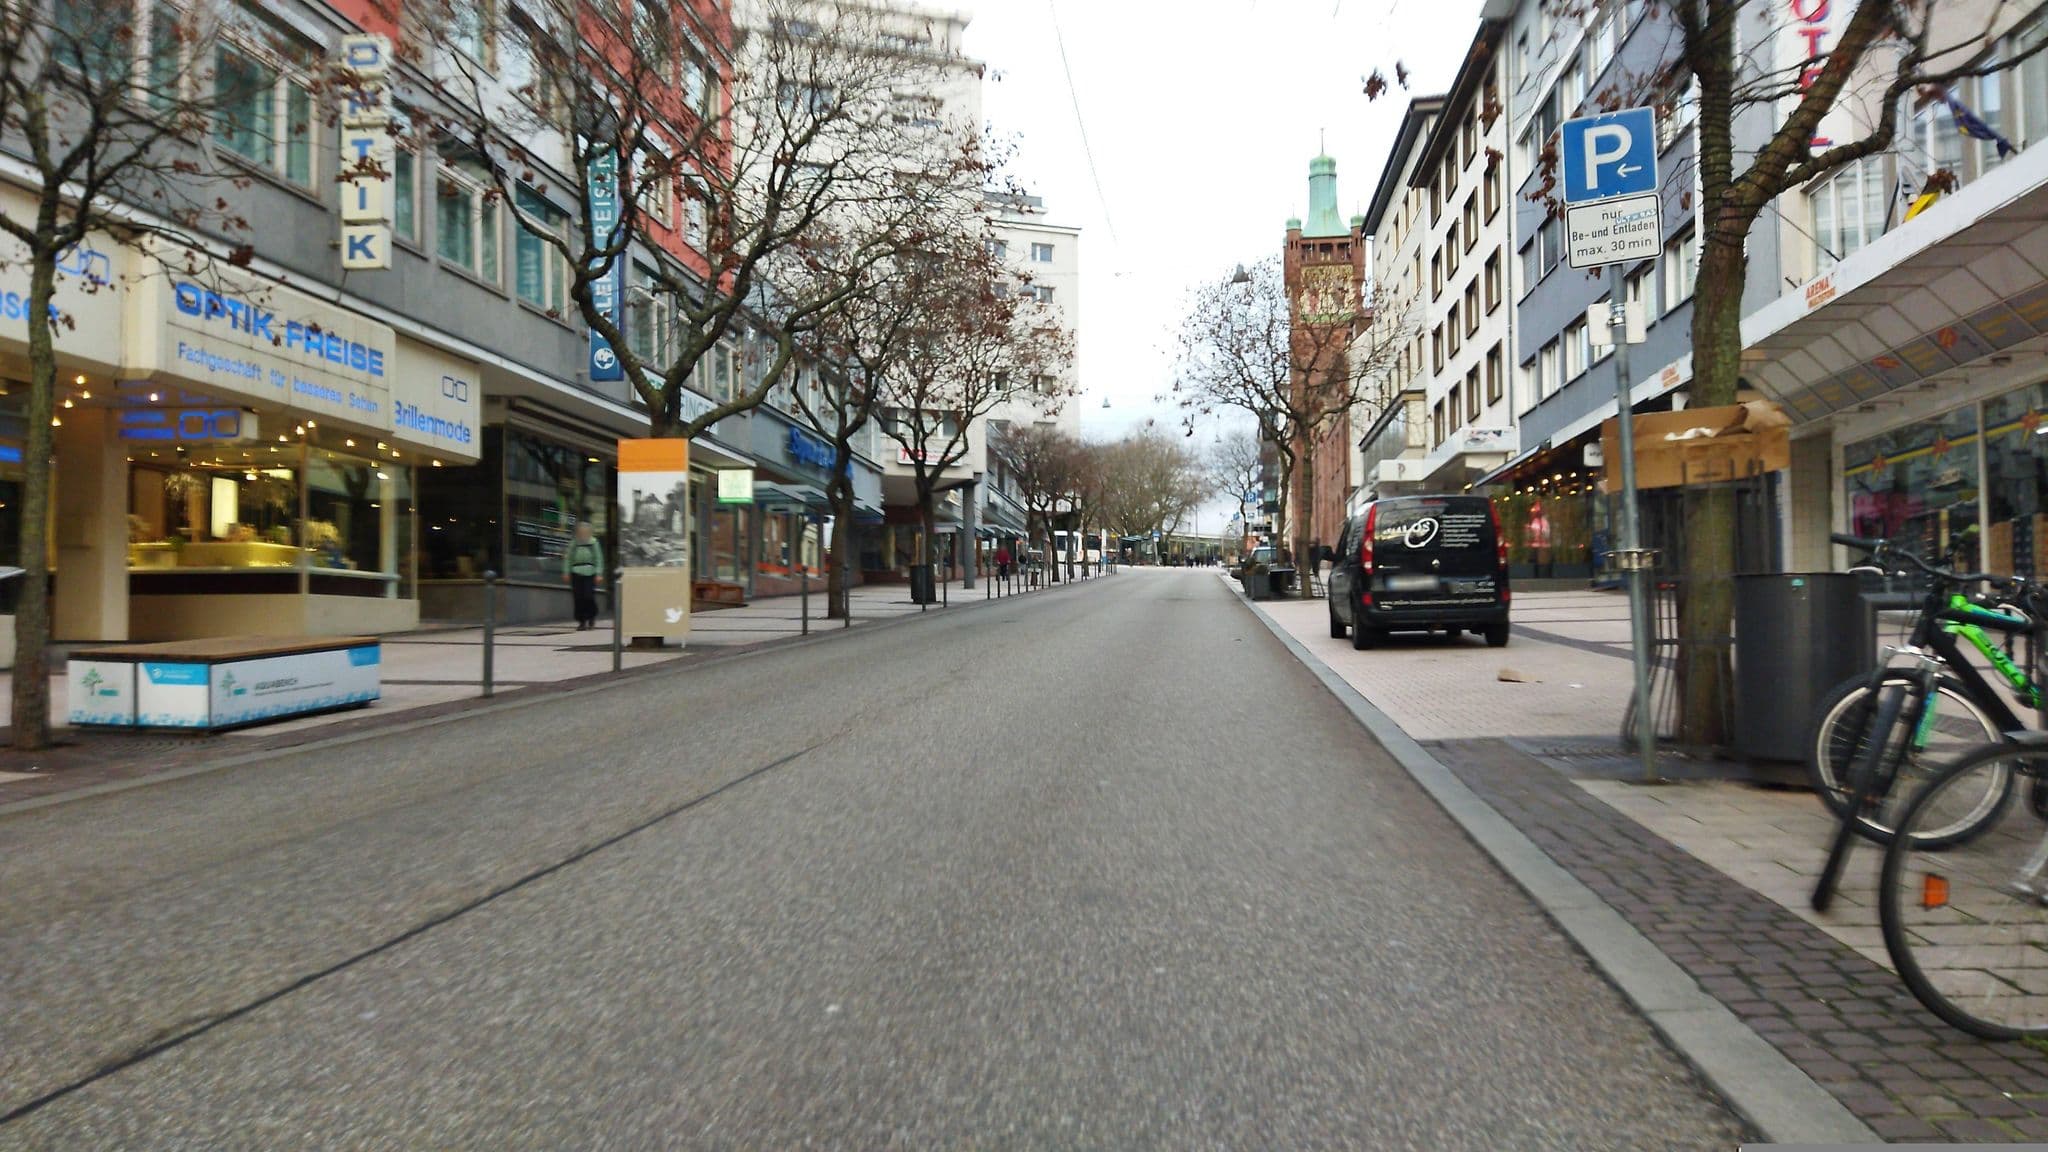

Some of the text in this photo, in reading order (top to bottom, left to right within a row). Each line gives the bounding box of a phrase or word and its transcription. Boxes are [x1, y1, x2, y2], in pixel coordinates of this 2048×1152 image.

[1791, 0, 1833, 148] OTE
[1584, 124, 1632, 190] P
[1602, 209, 1623, 221] nur
[1613, 220, 1655, 235] Entladen
[1577, 237, 1652, 258] max. 30 min
[176, 281, 385, 377] OPTIK FREISE
[178, 341, 263, 381] Fachgeschäft
[269, 368, 287, 389] für
[394, 400, 471, 444] Brillenmode
